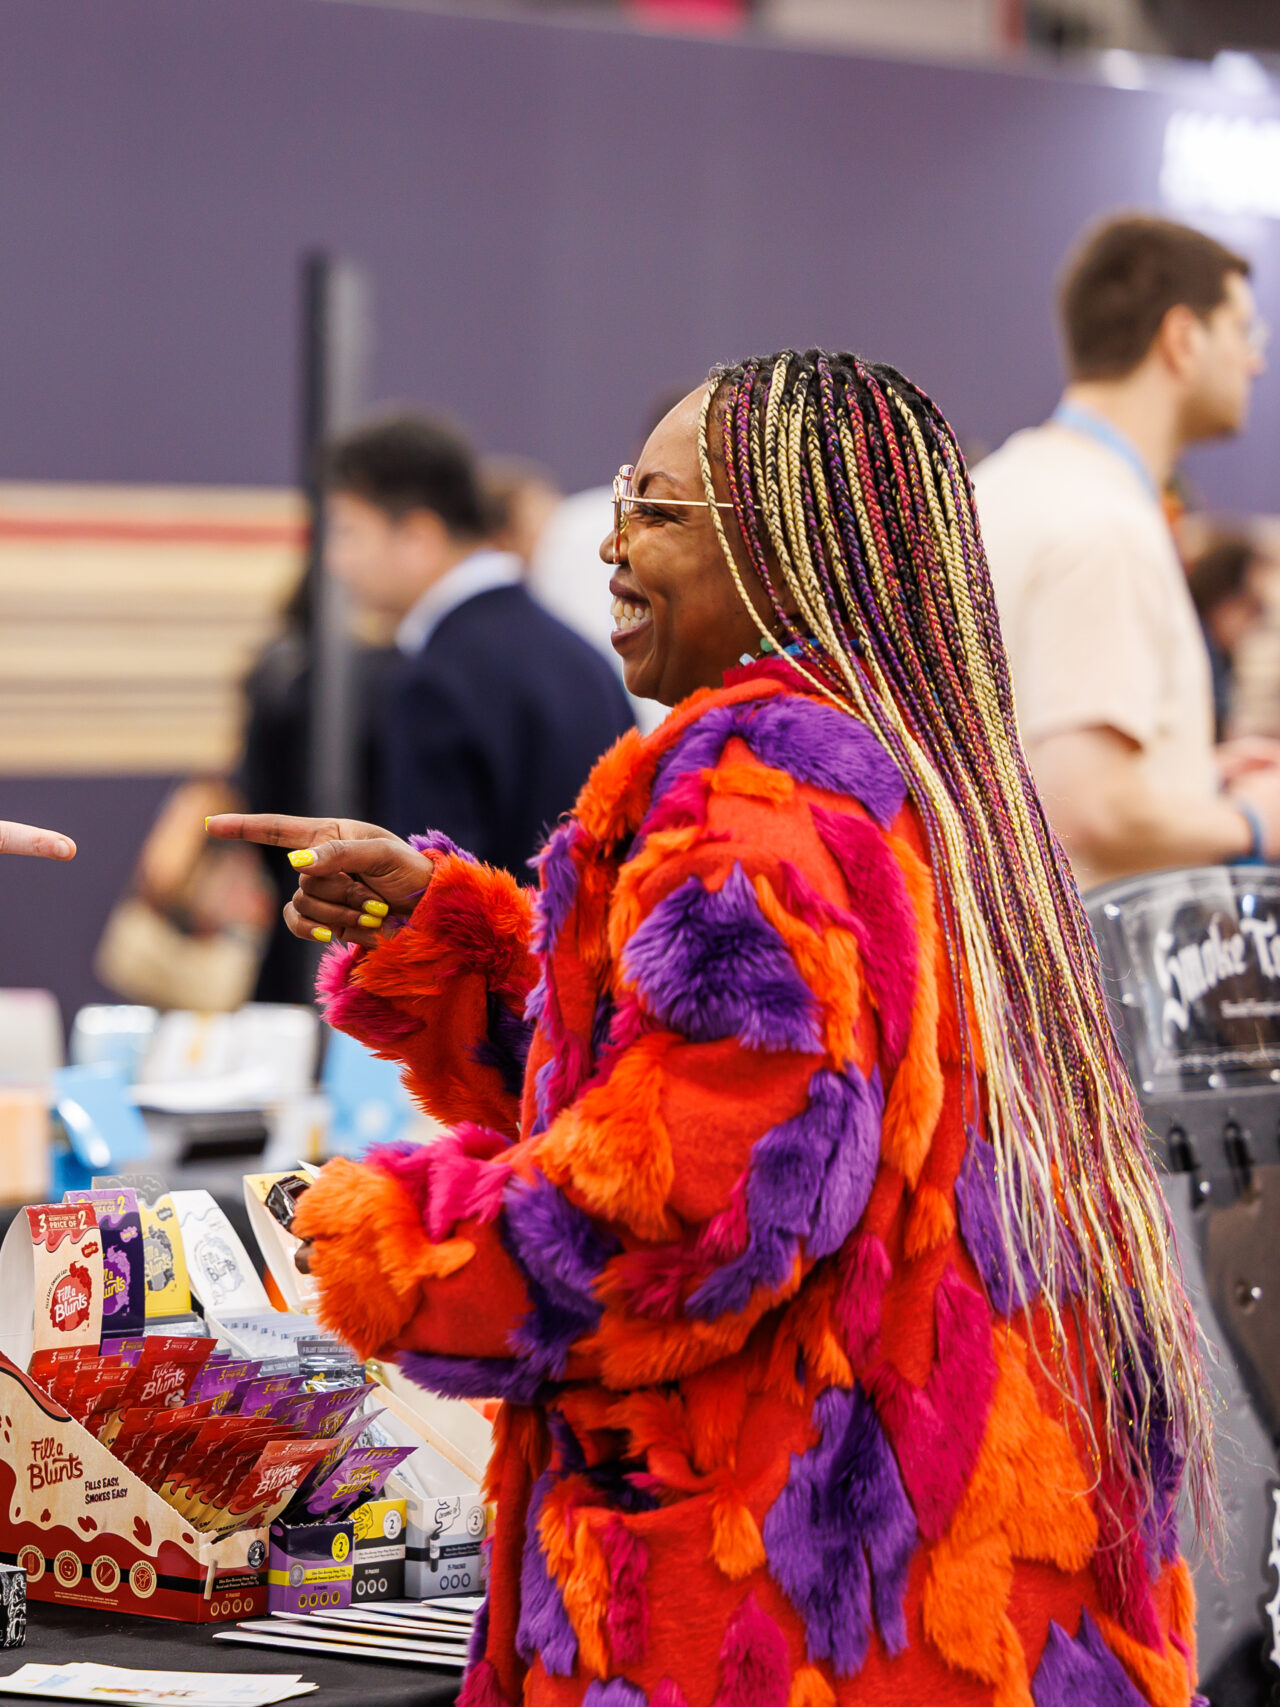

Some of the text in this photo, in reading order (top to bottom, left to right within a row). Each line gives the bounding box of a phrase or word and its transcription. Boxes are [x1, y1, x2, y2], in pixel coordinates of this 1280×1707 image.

[117, 1196, 127, 1215] 2
[38, 1210, 87, 1233] 3 2
[49, 1220, 77, 1228] PRICE OF
[57, 1284, 72, 1303] Fill
[103, 1275, 126, 1299] unts
[54, 1291, 88, 1323] Blunts
[163, 1339, 172, 1351] 3
[189, 1340, 198, 1351] 2
[50, 1351, 58, 1364] 3
[74, 1348, 81, 1360] 2
[140, 1368, 186, 1402] Blunts
[31, 1436, 63, 1462] Fill a
[27, 1452, 84, 1493] Blunts
[84, 1479, 101, 1492] FILLS
[84, 1487, 128, 1505] SMOKES EASY
[389, 1519, 395, 1530] 2
[473, 1515, 479, 1526] 2
[254, 1548, 260, 1559] 2
[338, 1541, 344, 1552] 2
